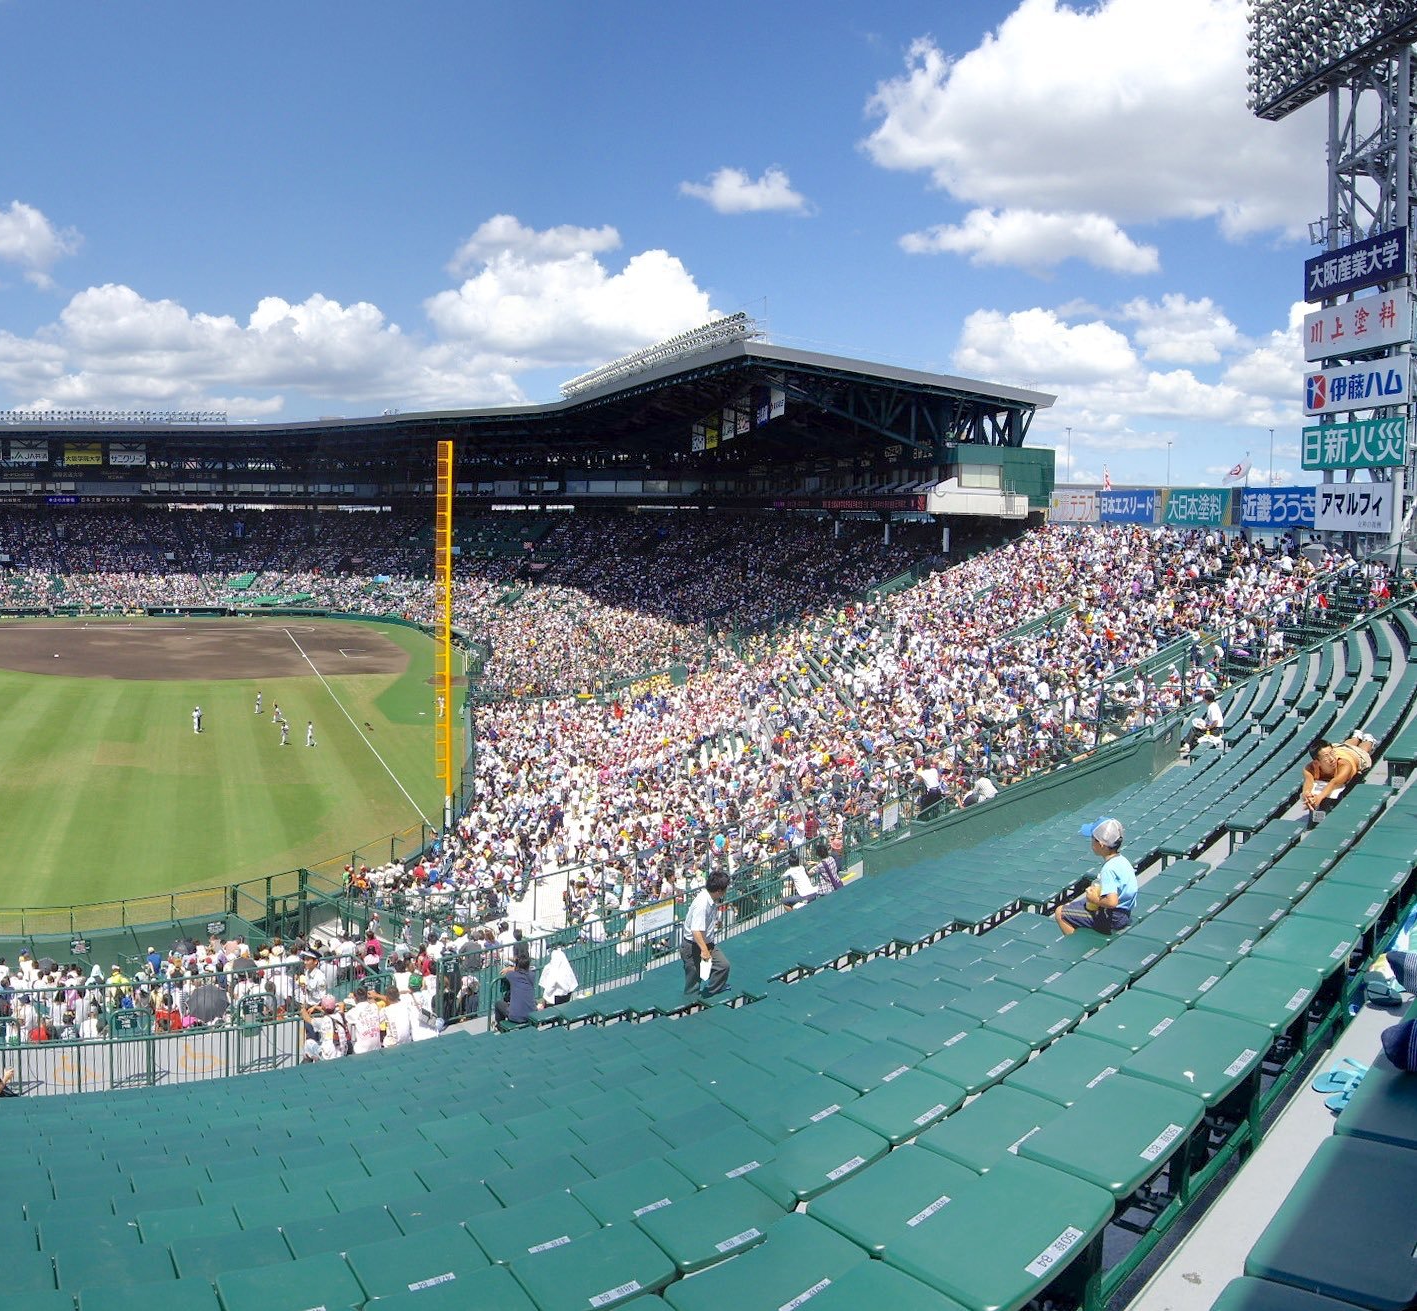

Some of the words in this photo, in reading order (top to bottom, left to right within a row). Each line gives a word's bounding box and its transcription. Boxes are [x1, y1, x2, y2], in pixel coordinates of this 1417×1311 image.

[1310, 238, 1399, 292] 大阪産業大学
[1310, 299, 1397, 344] 川上塗料
[1330, 368, 1404, 403] 伊藤ハム
[1303, 421, 1403, 466] 日新火災
[110, 455, 146, 463] サニクリーン
[1101, 497, 1154, 516] 日本エスリード
[1168, 493, 1222, 522] 大日本塗料
[1321, 493, 1383, 517] アマルフィ
[1054, 1231, 1077, 1252] 50段
[1036, 1254, 1053, 1268] 84
